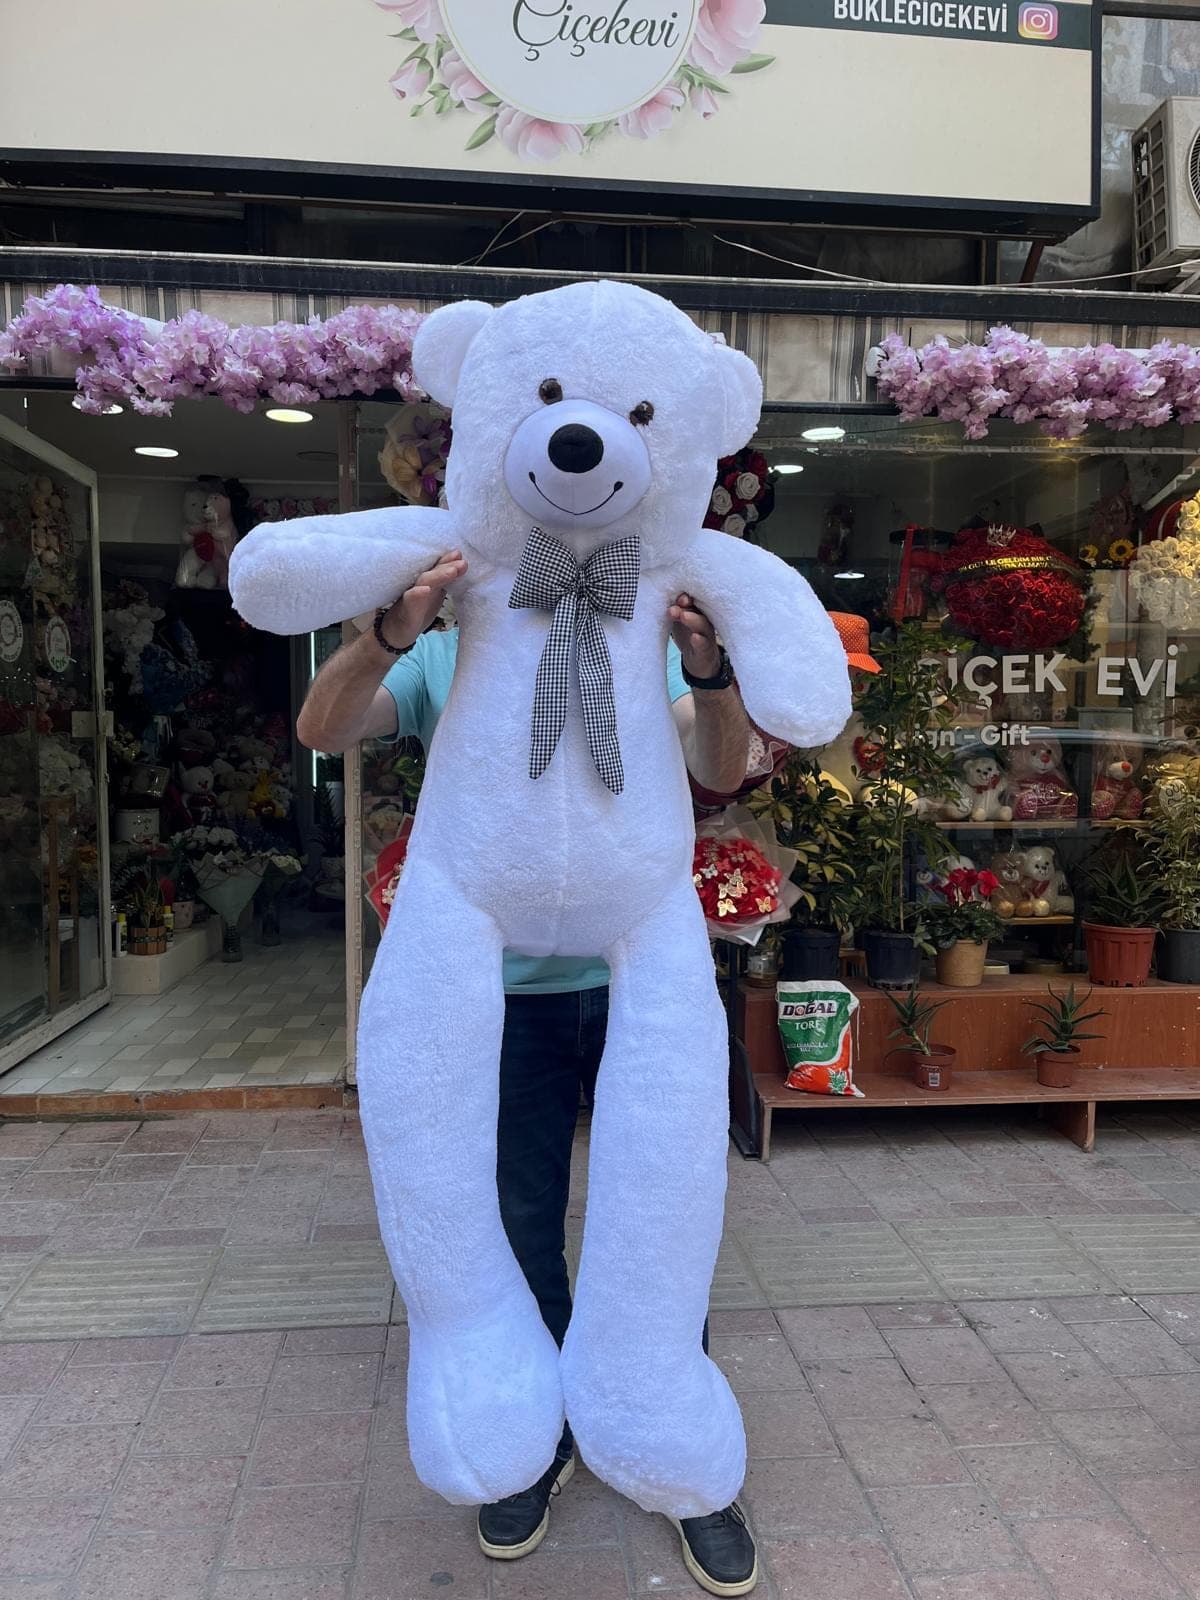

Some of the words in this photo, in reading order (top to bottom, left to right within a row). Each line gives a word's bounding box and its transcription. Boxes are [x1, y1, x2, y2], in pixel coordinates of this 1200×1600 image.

[1097, 644, 1177, 697] EVİ
[980, 723, 1031, 746] Gift
[782, 1000, 836, 1017] DOĞAL
